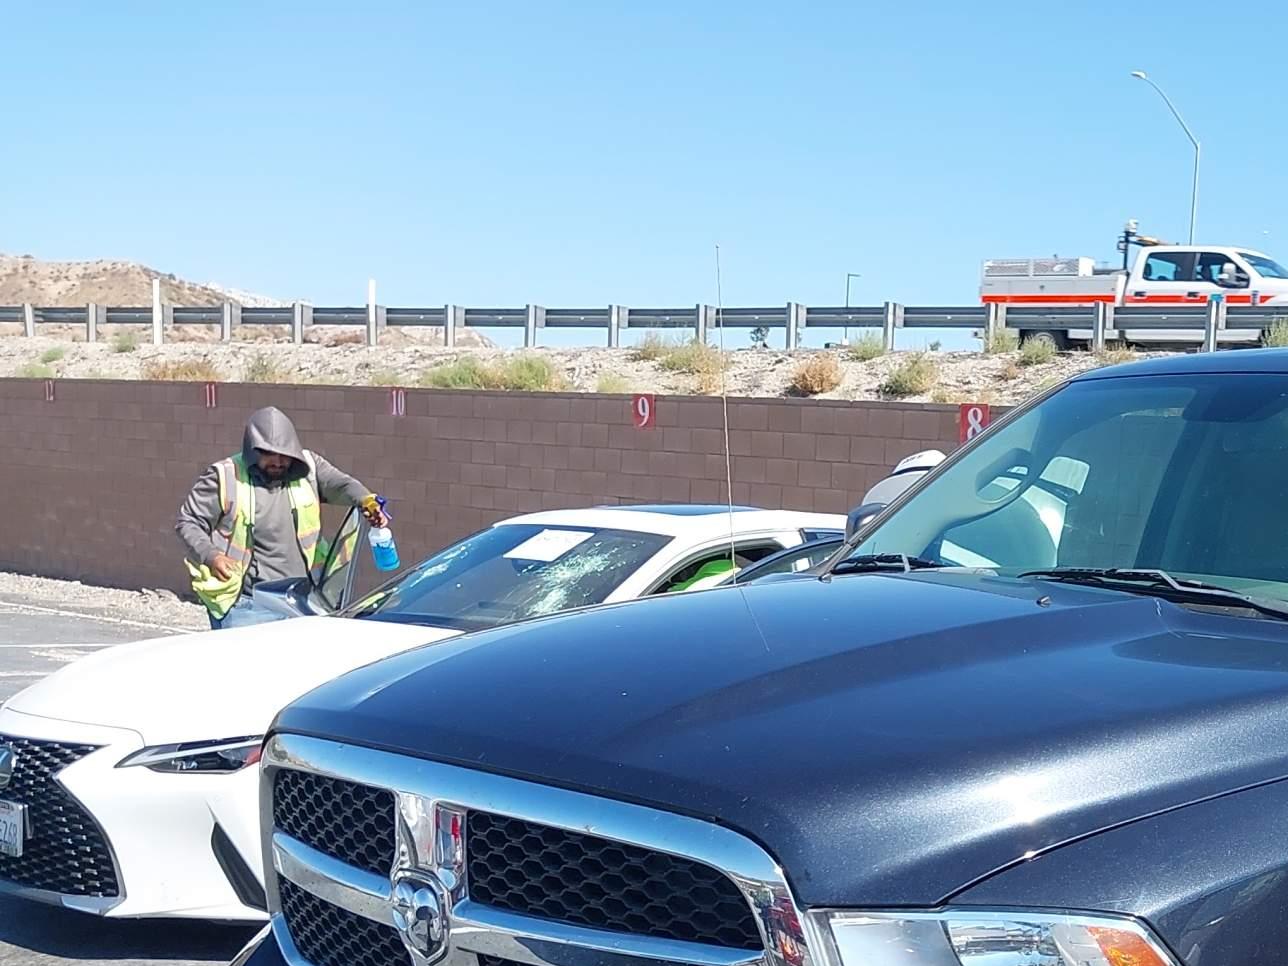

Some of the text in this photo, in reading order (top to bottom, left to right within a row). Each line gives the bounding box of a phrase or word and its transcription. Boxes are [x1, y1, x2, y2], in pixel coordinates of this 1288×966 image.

[206, 383, 216, 408] 11
[392, 390, 405, 416] 10
[638, 396, 650, 427] 9
[967, 407, 983, 441] 8
